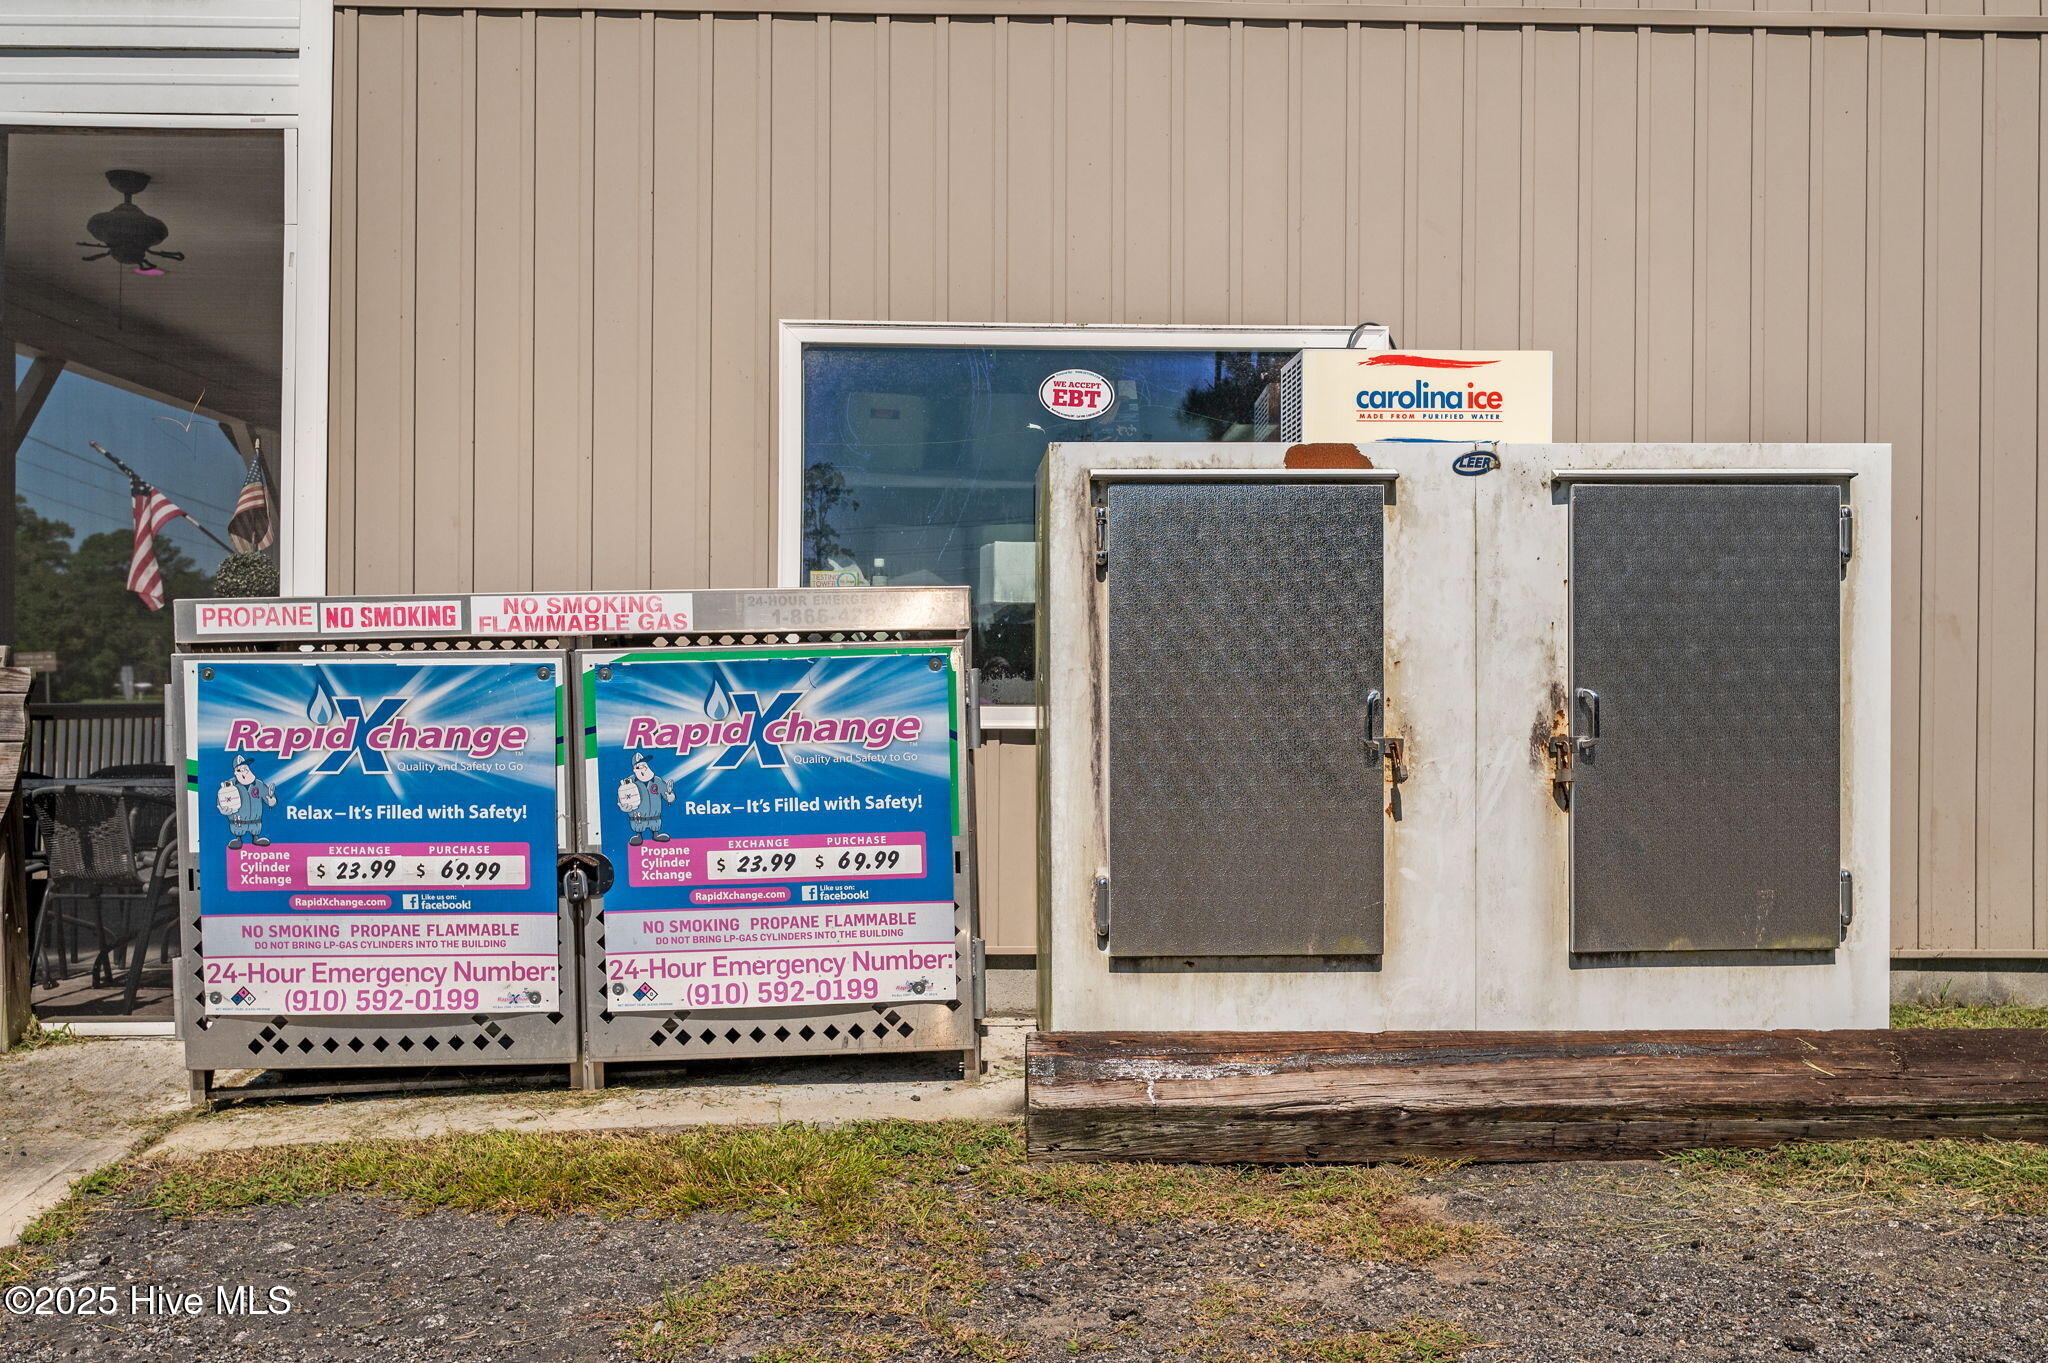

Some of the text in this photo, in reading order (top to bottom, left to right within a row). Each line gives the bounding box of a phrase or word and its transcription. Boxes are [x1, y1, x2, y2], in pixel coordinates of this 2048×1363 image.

[1069, 381, 1101, 389] ACCEPT
[1052, 389, 1101, 408] EBT
[1356, 380, 1503, 409] carolina ice
[1459, 456, 1491, 468] LEER
[503, 595, 663, 614] NO SMOKING
[747, 595, 807, 607] 24-HOUR
[202, 606, 312, 628] PROPANE
[326, 605, 457, 628] NO SMOKING
[479, 613, 688, 632] FLAMMABLE GAS
[224, 696, 528, 774] RapidXchange
[623, 690, 922, 770] RapidXchange
[793, 752, 918, 766] Quality and Safety to Go
[397, 761, 524, 774] Quality and Safety to Go
[774, 797, 820, 813] Filled
[824, 796, 861, 812] with
[865, 794, 922, 813] Safety!
[377, 805, 424, 820] Filled
[427, 805, 464, 819] with
[469, 804, 527, 822] Safety!
[728, 838, 789, 849] EXCHANGE
[827, 836, 887, 846] PURCHASE
[240, 850, 290, 863] Propane
[328, 846, 391, 855] EXCHANGE
[428, 846, 490, 854] PURCHASE
[641, 846, 690, 858] Propane
[240, 862, 290, 874] Cylinder
[641, 858, 690, 870] Cylinder
[717, 852, 796, 872] $ 23.99
[816, 850, 900, 872] $ 69.99
[316, 860, 396, 880] $ 23.99
[416, 858, 501, 880] $ 69.99
[642, 869, 692, 882] Xchange
[241, 874, 292, 886] Xchange
[696, 890, 786, 902] RapidXchange.com
[820, 890, 868, 900] facebook!
[295, 898, 386, 908] RapidXchange.com
[421, 900, 471, 910] facebook!
[242, 923, 520, 938] NO SMOKING PROPANE FLAMMABLE
[643, 912, 916, 934] NO SMOKING PROPANE FLAMMABLE
[656, 928, 904, 945] DO NOT BRING LP-GAS CYLINDERS INTO THE BUILDING
[254, 940, 506, 950] DO NOT BRING LP-GAS CYLINDERS INTO THE BUILDING
[609, 950, 953, 981] 24-Hour Emergency Number:
[208, 961, 556, 988] 24-Hour Emergency Number:
[687, 978, 878, 1006] (910) 592-0199
[284, 988, 479, 1012] (910) 592-0199
